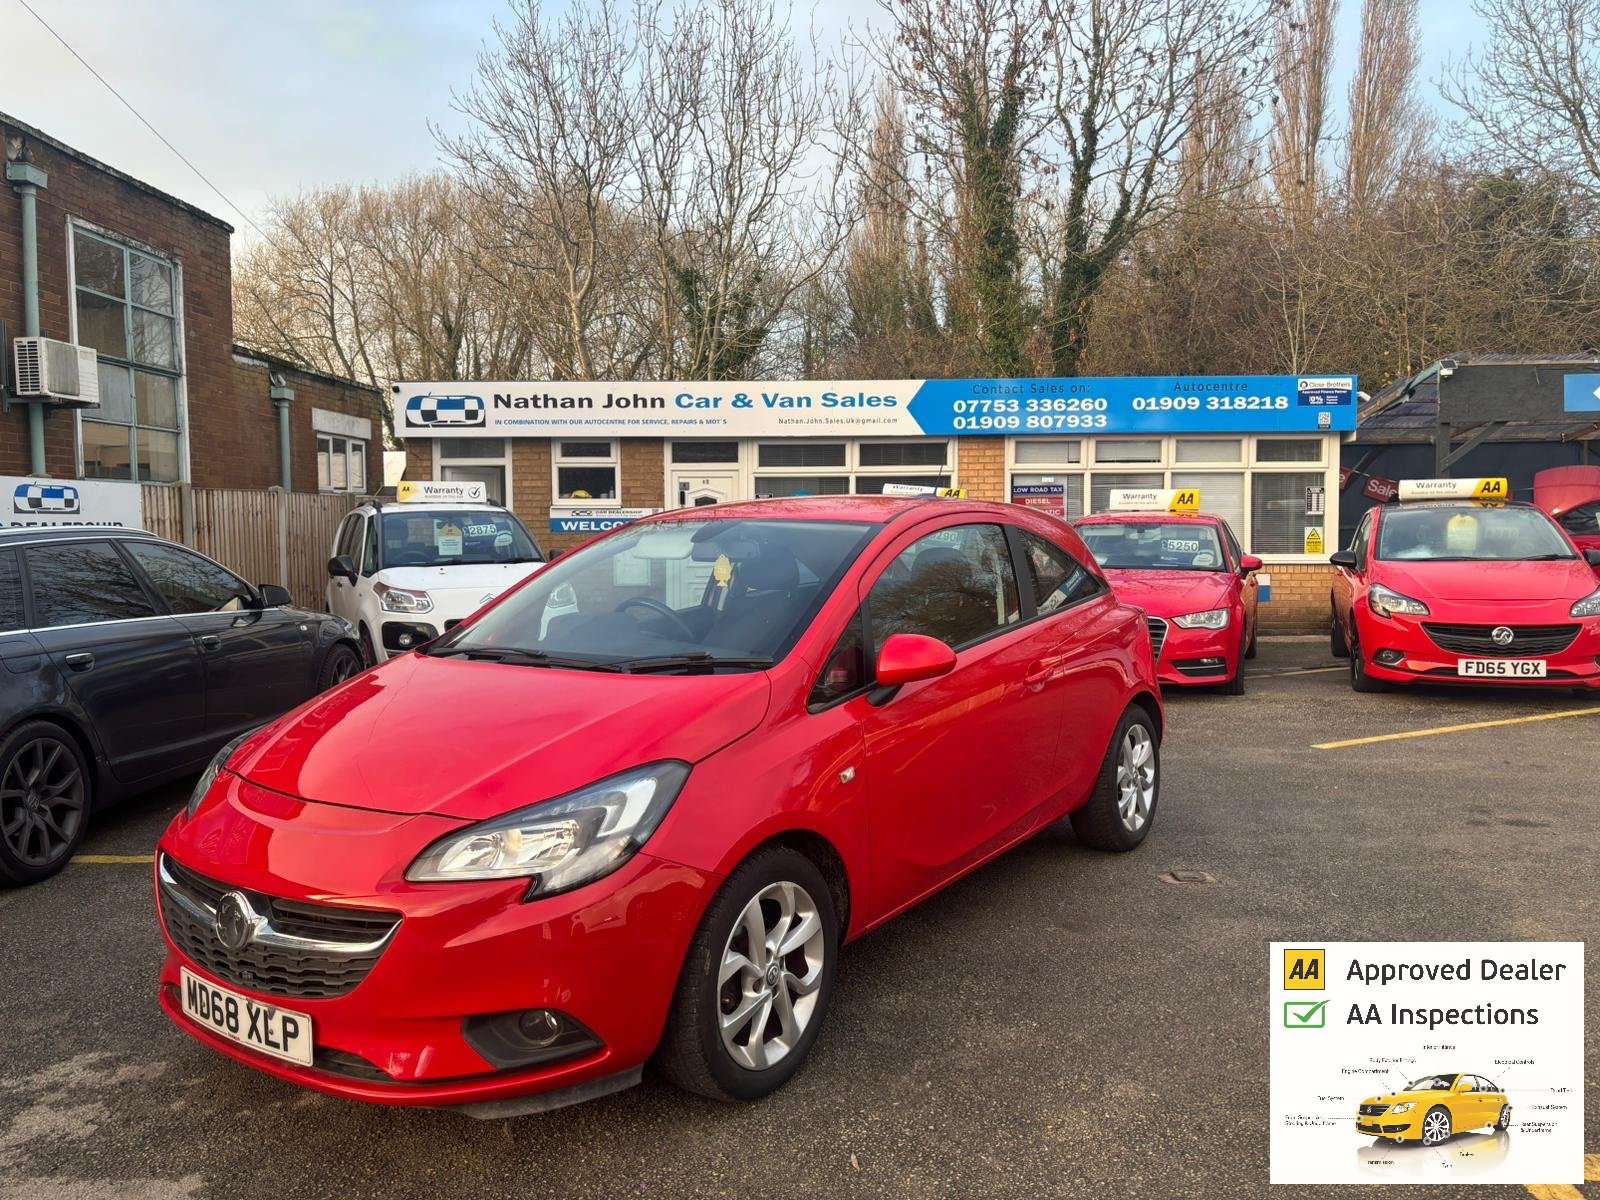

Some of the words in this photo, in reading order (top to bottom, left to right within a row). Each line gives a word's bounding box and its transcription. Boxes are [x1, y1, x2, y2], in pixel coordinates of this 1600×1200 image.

[972, 384, 1025, 395] Contact
[1030, 383, 1065, 393] Sales
[1174, 382, 1249, 392] Autocentre
[494, 393, 593, 409] Nathan
[602, 393, 665, 409] John
[675, 393, 722, 409] Car
[731, 393, 754, 408] &
[761, 393, 812, 408] Van
[821, 392, 897, 408] Sales
[953, 399, 1019, 413] 07753
[1026, 398, 1108, 412] 336260
[1132, 397, 1200, 411] 01909
[1206, 396, 1289, 410] 318218
[953, 415, 1020, 429] 01909
[1026, 414, 1108, 429] 807933
[424, 486, 464, 495] Warranty
[1481, 481, 1500, 493] AA
[944, 489, 960, 498] AA
[1177, 492, 1194, 504] AA
[1465, 661, 1506, 674] FD65
[1511, 662, 1541, 674] YGX
[186, 976, 240, 1034] MD68
[246, 1004, 299, 1052] XLP
